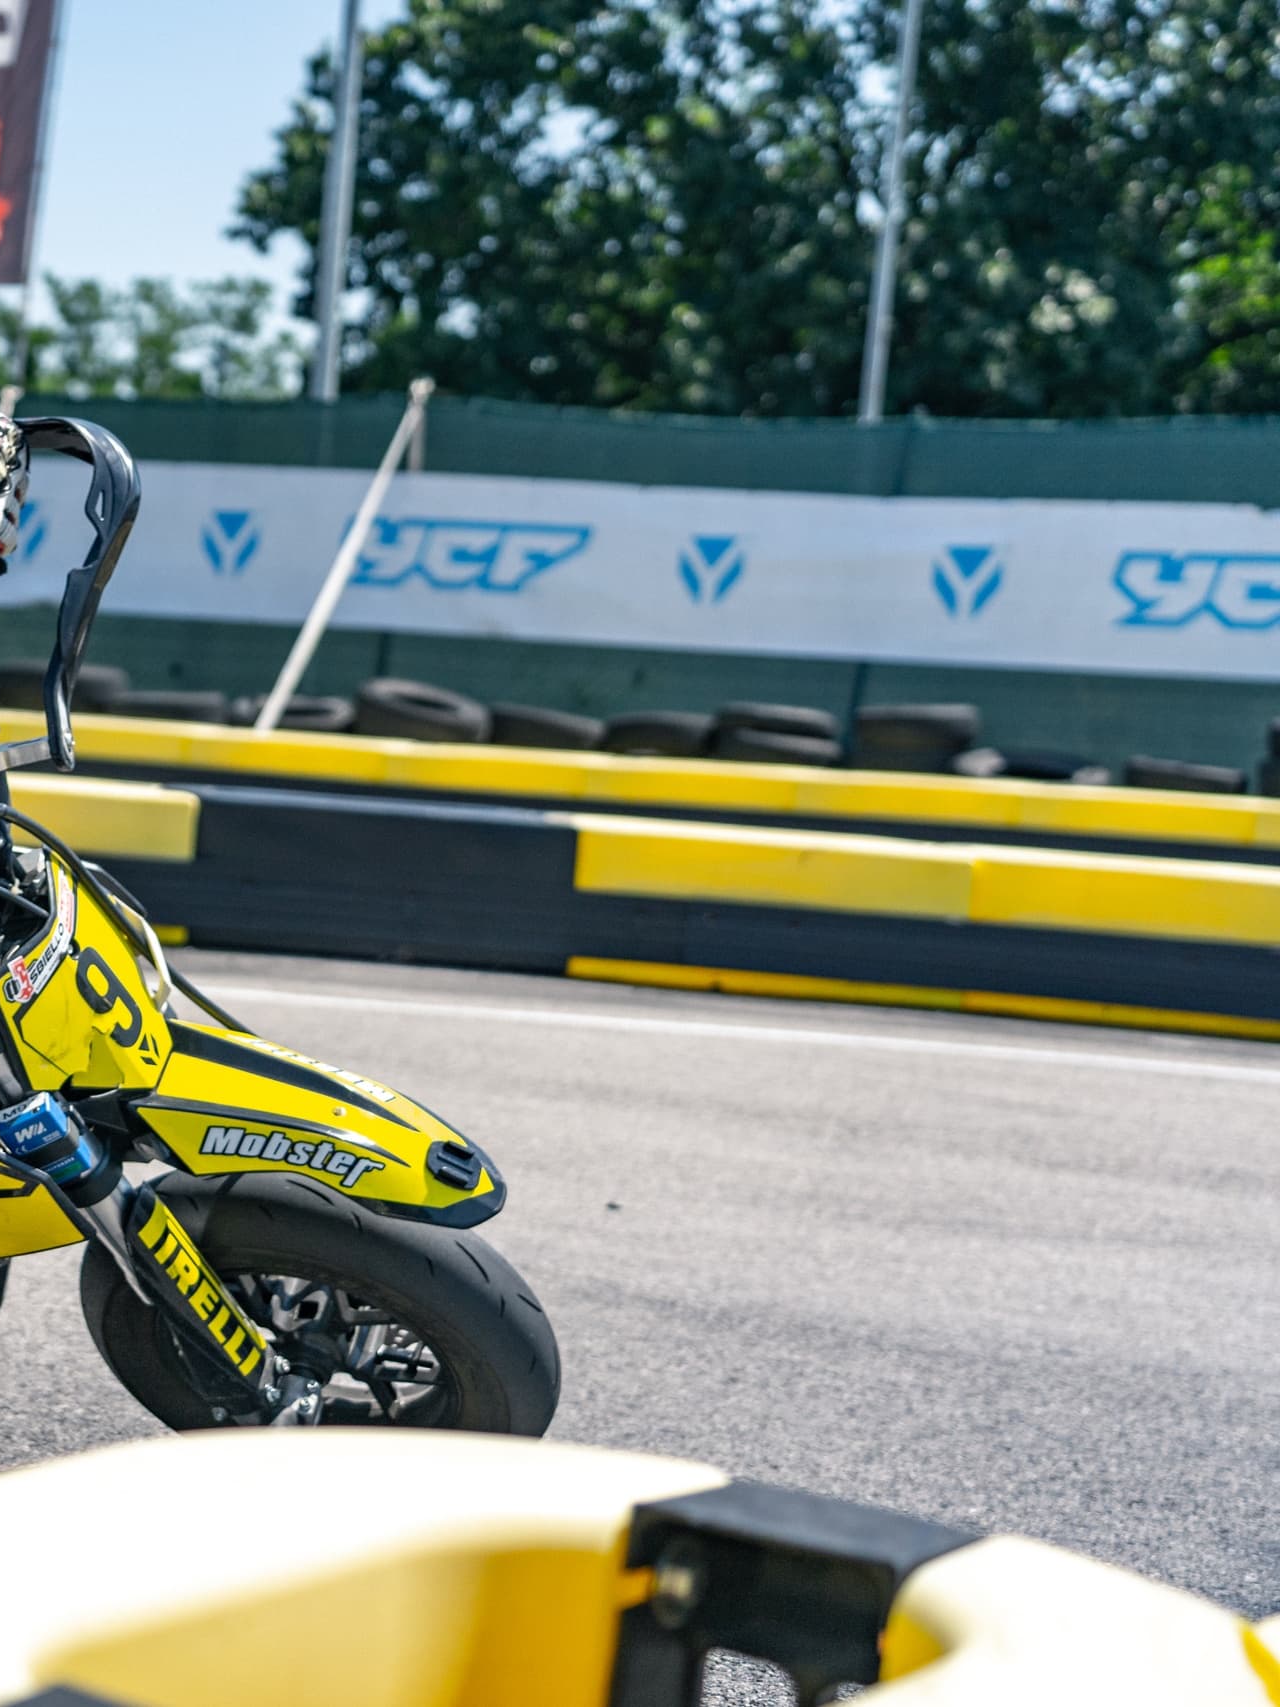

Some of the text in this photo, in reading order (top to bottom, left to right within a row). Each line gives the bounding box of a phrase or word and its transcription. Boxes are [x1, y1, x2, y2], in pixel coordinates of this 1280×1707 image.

[340, 517, 592, 592] YCF
[1113, 551, 1280, 630] YC
[30, 922, 65, 986] SBIELLO
[76, 946, 143, 1048] 9
[200, 1126, 384, 1189] Mobster
[136, 1194, 268, 1377] PIRELLI
